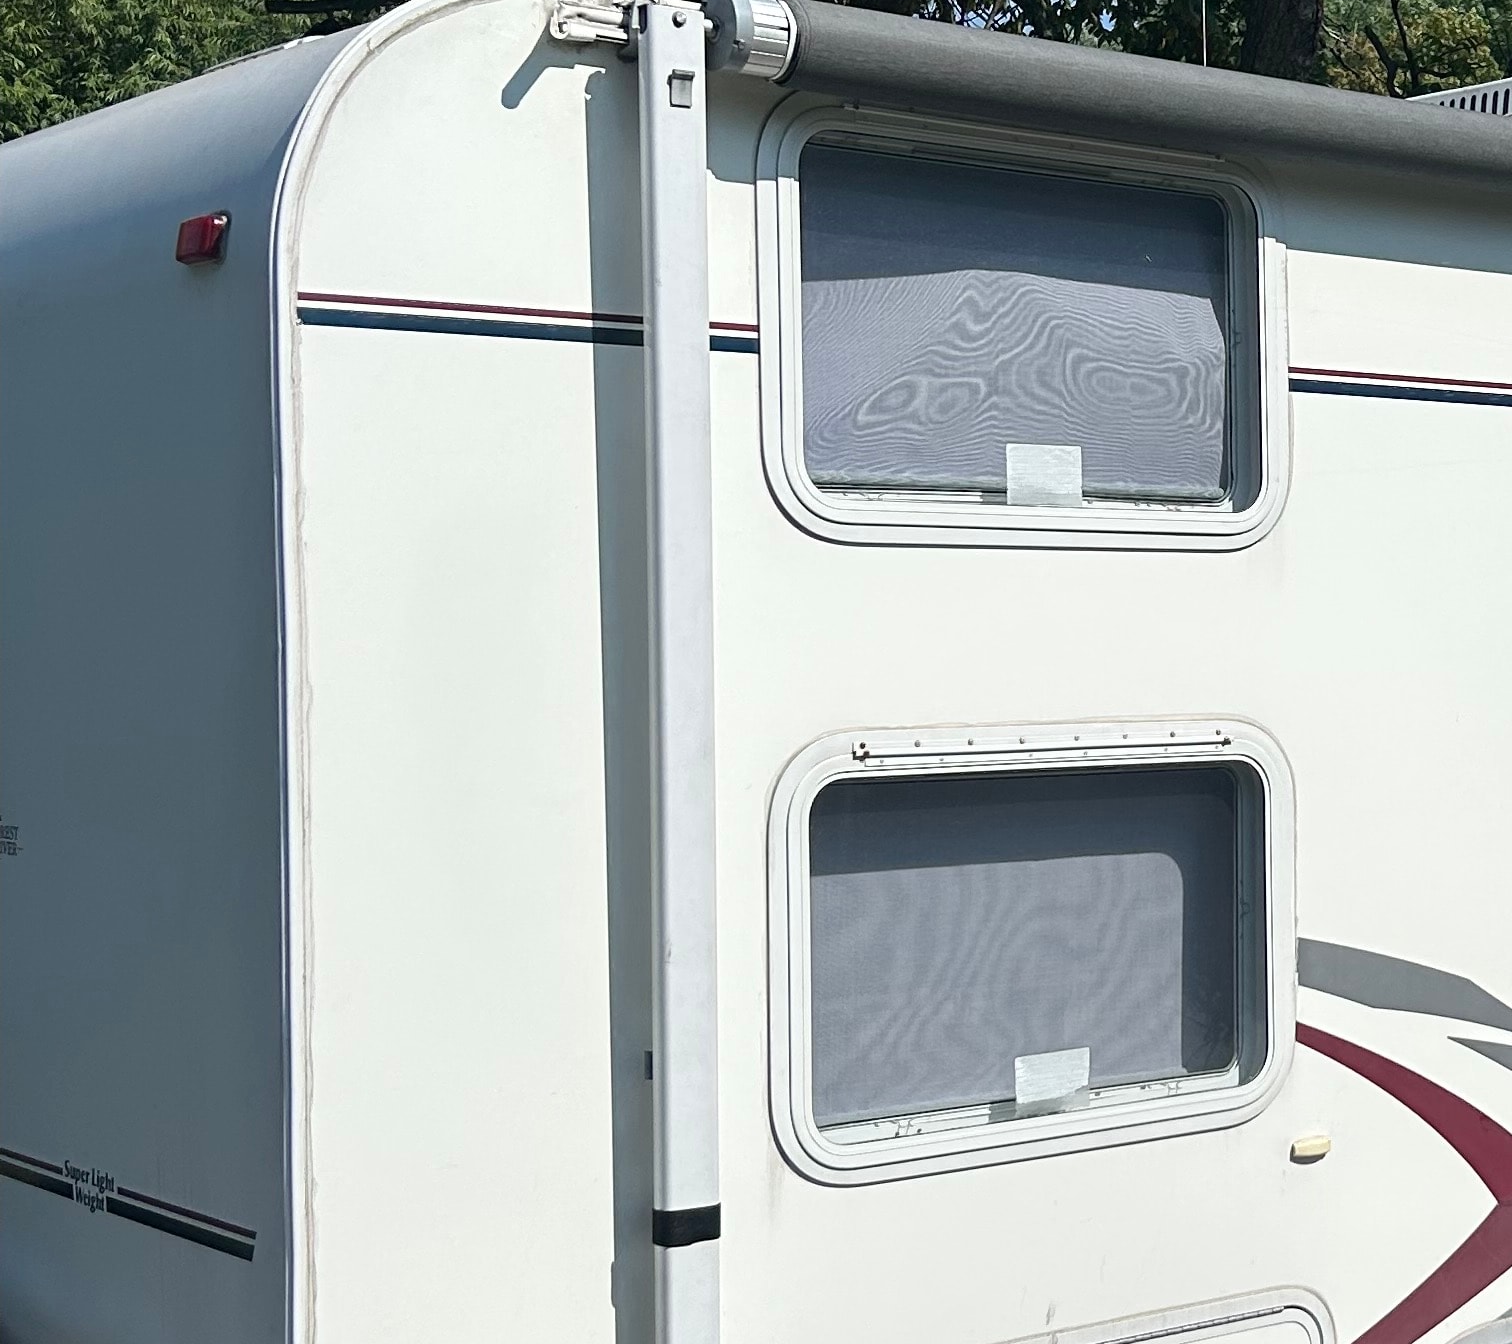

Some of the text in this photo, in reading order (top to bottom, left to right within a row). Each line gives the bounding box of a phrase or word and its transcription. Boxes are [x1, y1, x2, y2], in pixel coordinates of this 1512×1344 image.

[65, 1160, 114, 1194] Super Light
[76, 1186, 105, 1213] Weight
